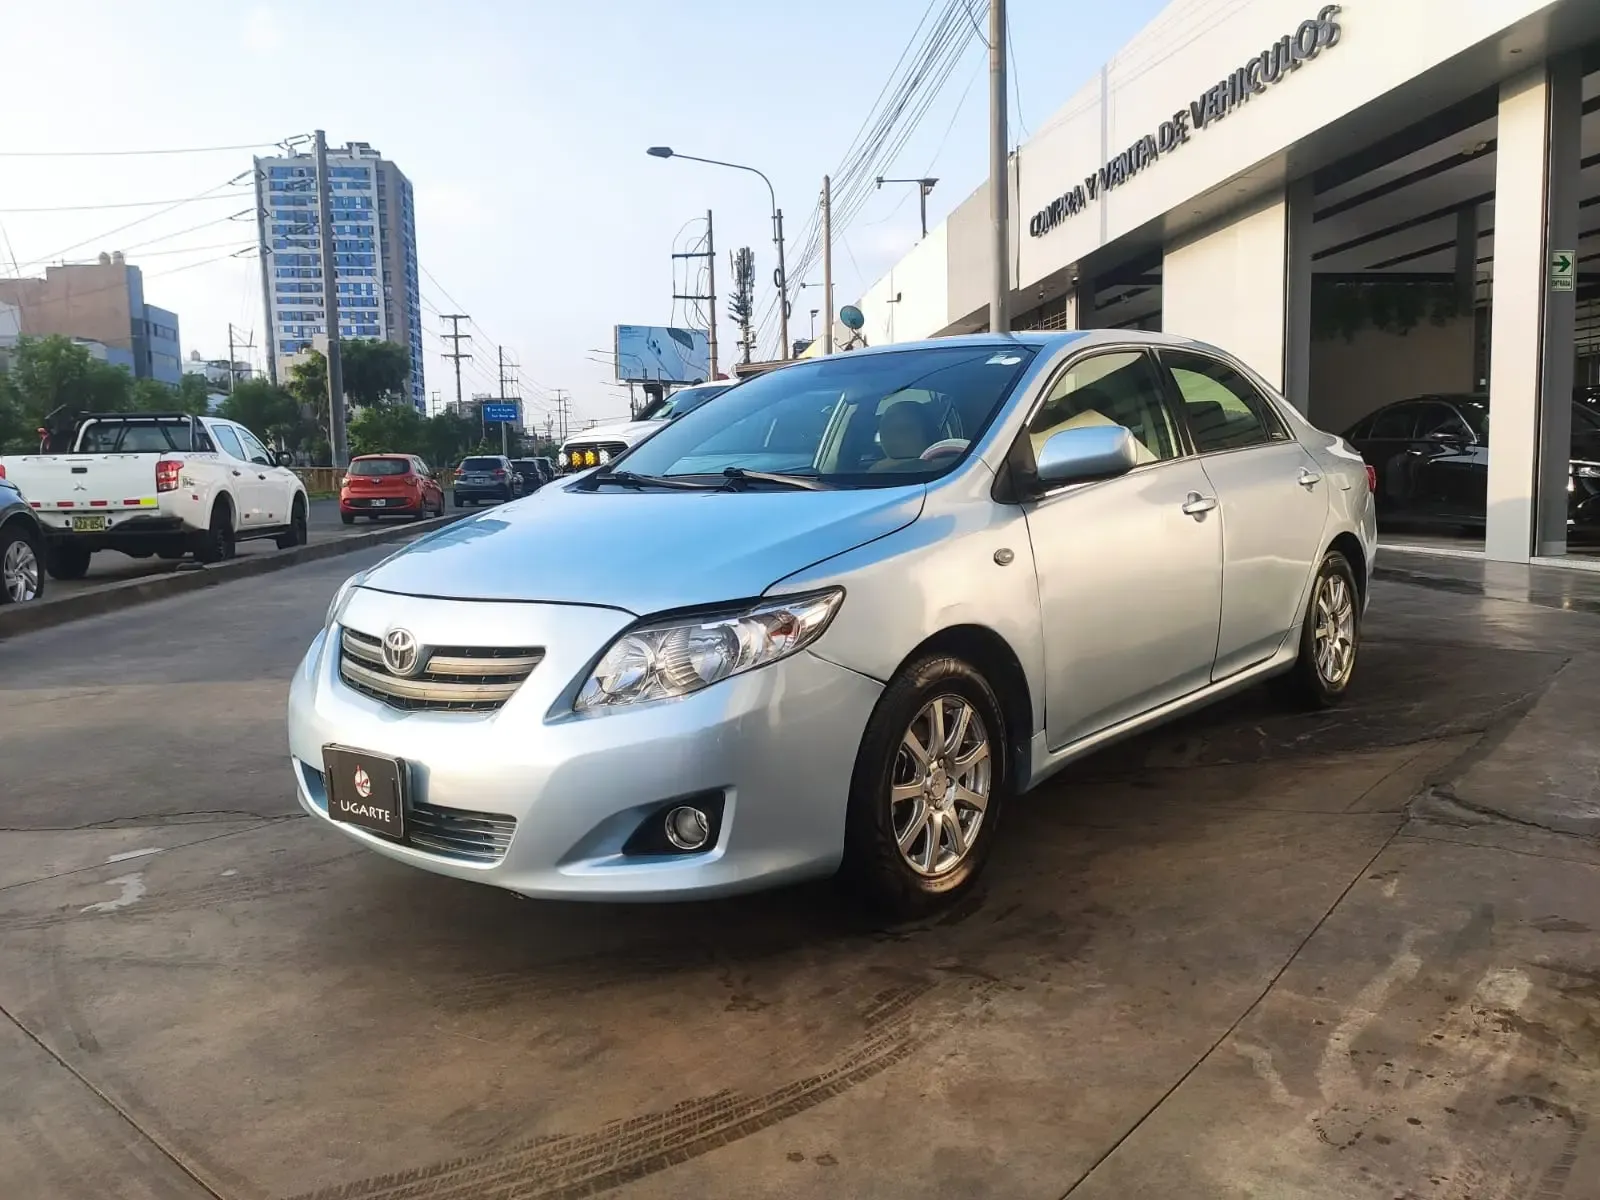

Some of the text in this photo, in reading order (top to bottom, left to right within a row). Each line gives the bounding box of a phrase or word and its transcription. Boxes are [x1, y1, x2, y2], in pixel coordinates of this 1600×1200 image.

[1030, 4, 1342, 238] COMPRA Y VENTA DE VEHICULOS
[340, 799, 391, 822] UGARTE
